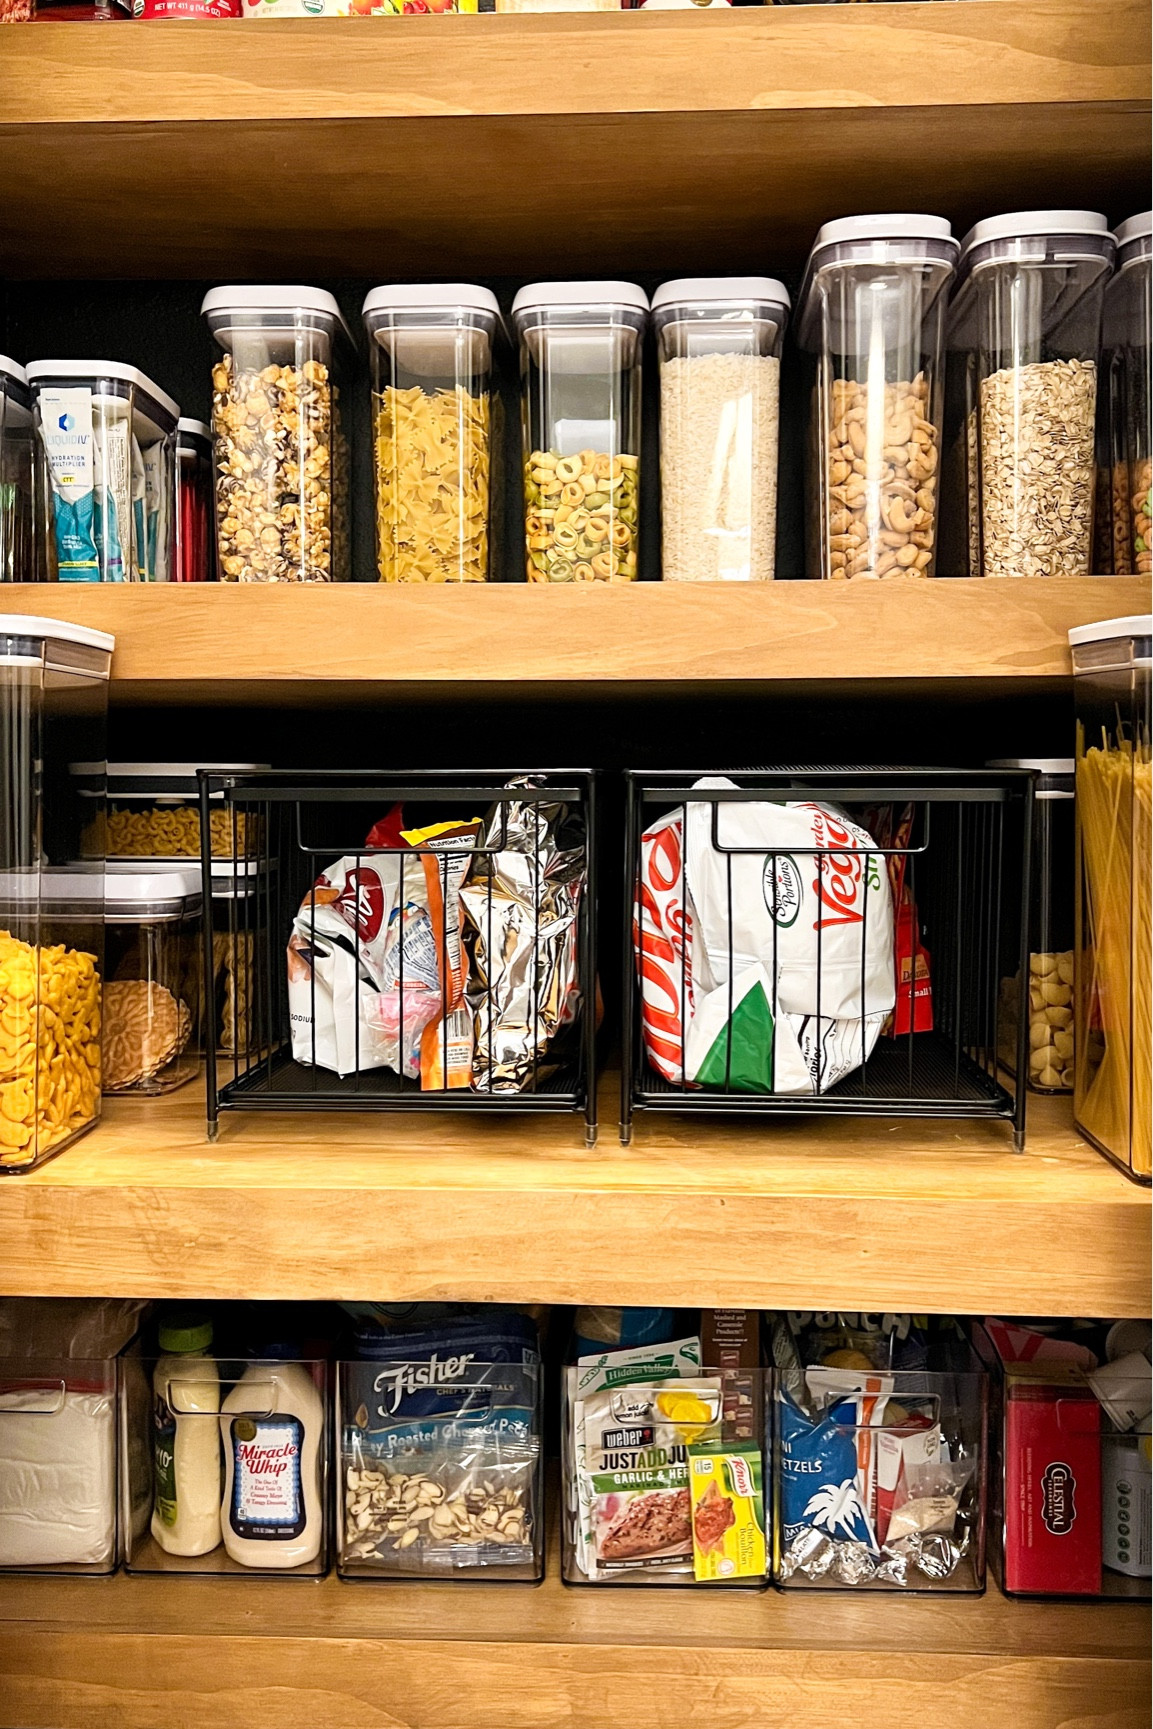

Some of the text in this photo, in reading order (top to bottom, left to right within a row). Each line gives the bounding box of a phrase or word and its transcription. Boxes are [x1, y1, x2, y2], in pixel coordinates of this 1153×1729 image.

[154, 3, 166, 11] NET
[166, 2, 177, 10] WT
[781, 859, 797, 908] Portions
[608, 1366, 643, 1381] Hidden
[373, 1352, 475, 1418] Fisher
[387, 1426, 438, 1449] Roasted
[606, 1429, 643, 1448] weber
[237, 1443, 298, 1462] Miracle
[246, 1459, 288, 1478] Whip
[613, 1470, 654, 1485] GARLIC
[731, 1460, 749, 1495] Knorr
[1051, 1468, 1068, 1529] CELESTIAL
